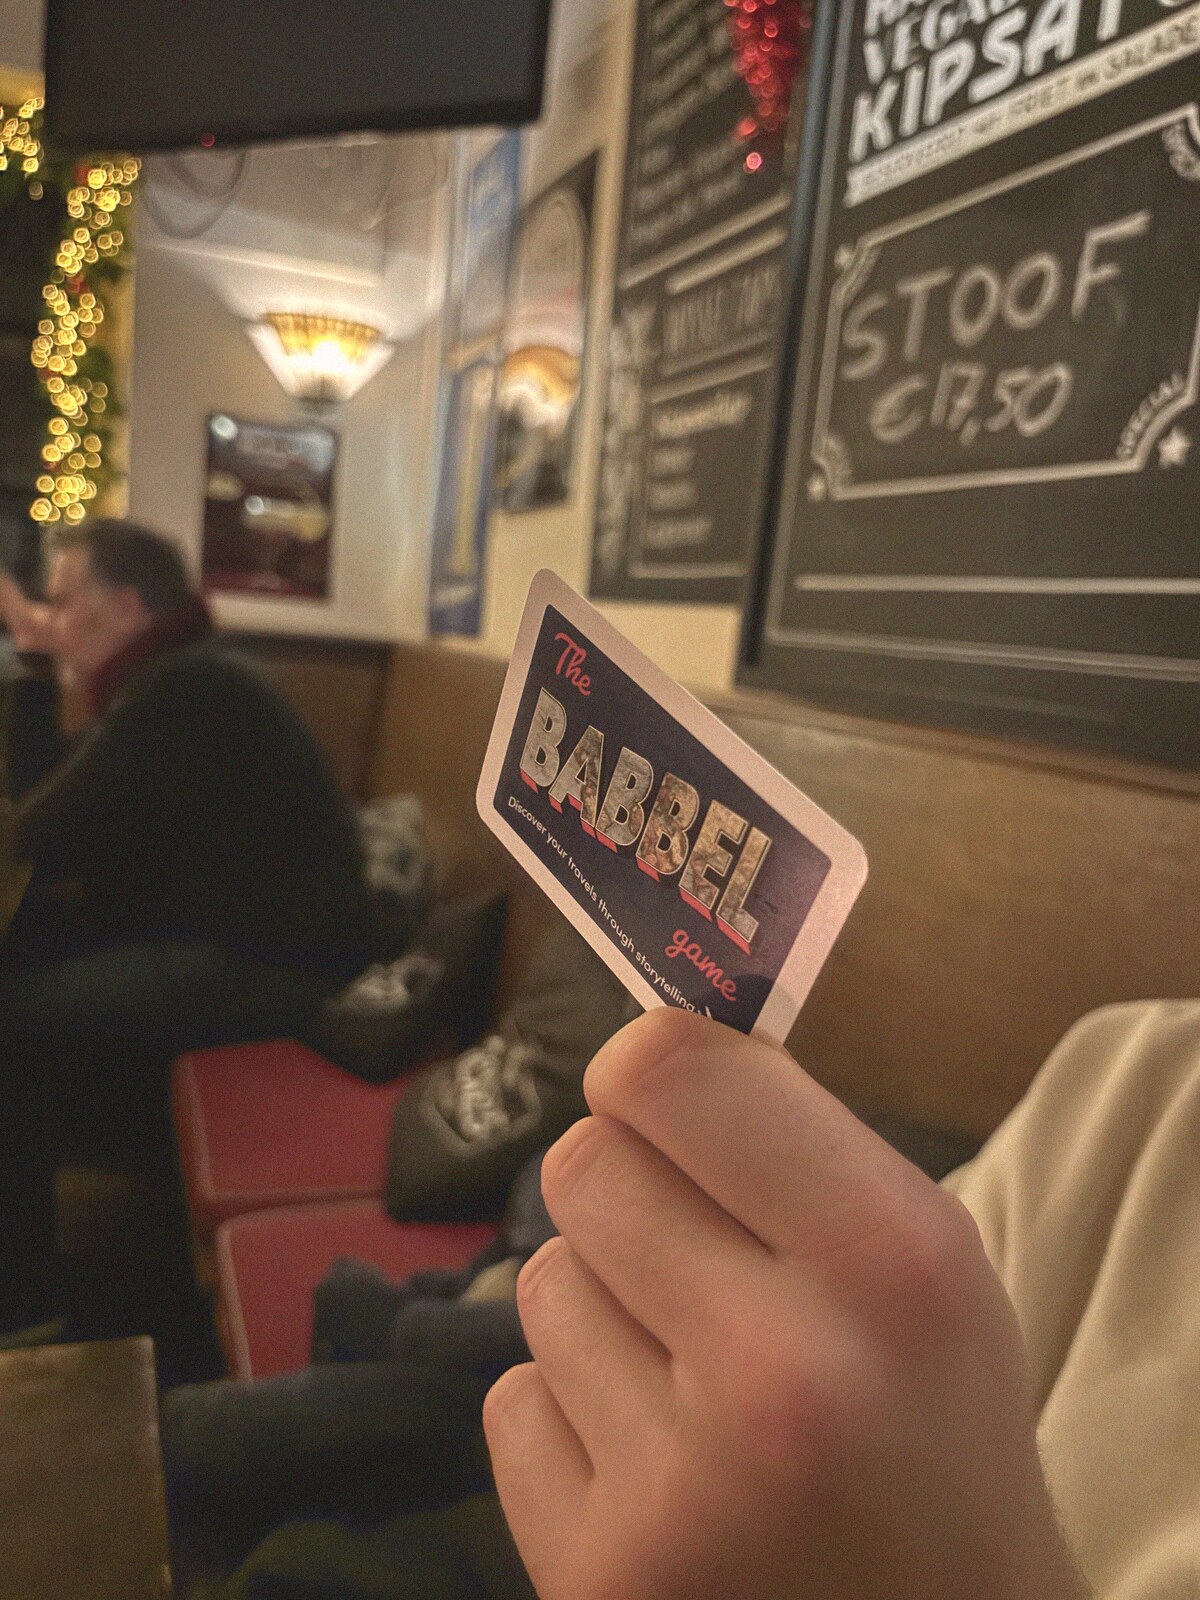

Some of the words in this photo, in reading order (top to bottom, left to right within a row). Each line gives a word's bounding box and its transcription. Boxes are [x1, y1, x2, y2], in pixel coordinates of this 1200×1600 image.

[842, 209, 1151, 381] STOOF
[554, 632, 592, 697] The
[508, 796, 548, 835] Discover
[545, 832, 568, 860] your
[567, 856, 598, 902] travels
[598, 899, 635, 953] through
[635, 951, 697, 1014] storytelling
[519, 687, 772, 954] BABBEL
[664, 929, 737, 1002] game
